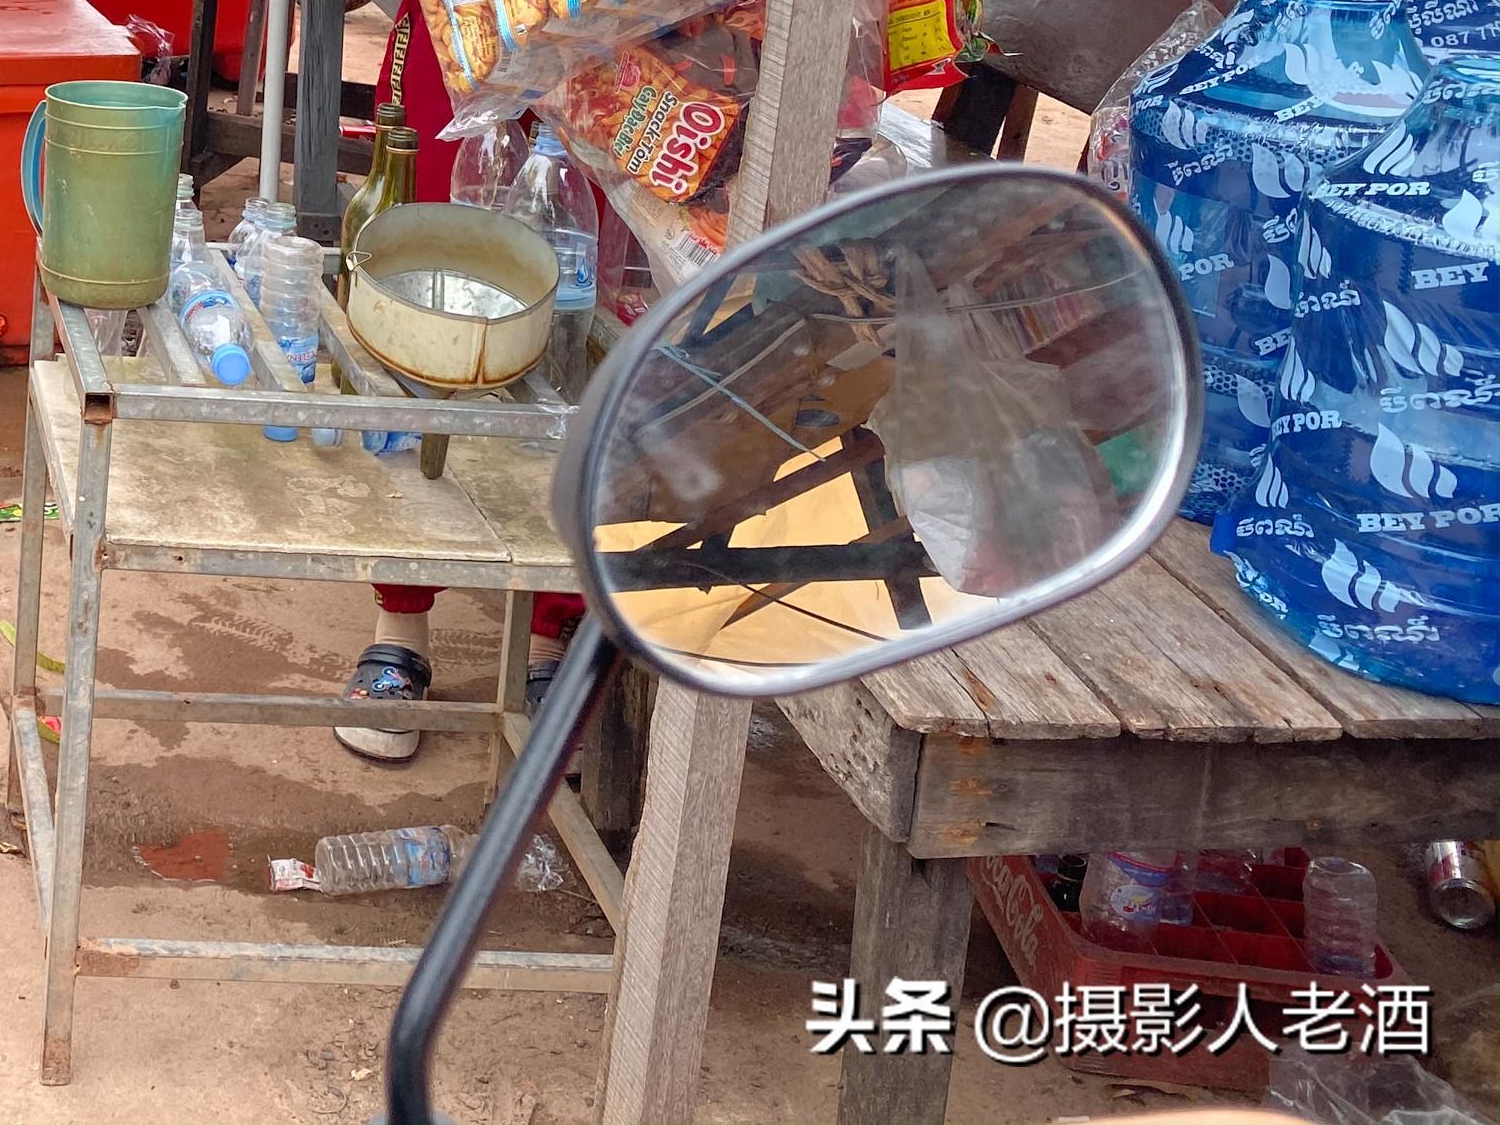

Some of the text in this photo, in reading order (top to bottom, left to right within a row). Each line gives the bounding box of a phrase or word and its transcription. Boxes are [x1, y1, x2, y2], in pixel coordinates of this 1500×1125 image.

[1430, 31, 1470, 47] 087
[631, 83, 659, 114] Cay
[626, 91, 681, 176] Snack Tôm
[1364, 181, 1431, 197] POR
[1178, 253, 1235, 282] POR
[1412, 261, 1490, 290] BEY
[1254, 327, 1293, 356] BE
[1292, 410, 1343, 435] POR
[1356, 512, 1426, 534] BEY
